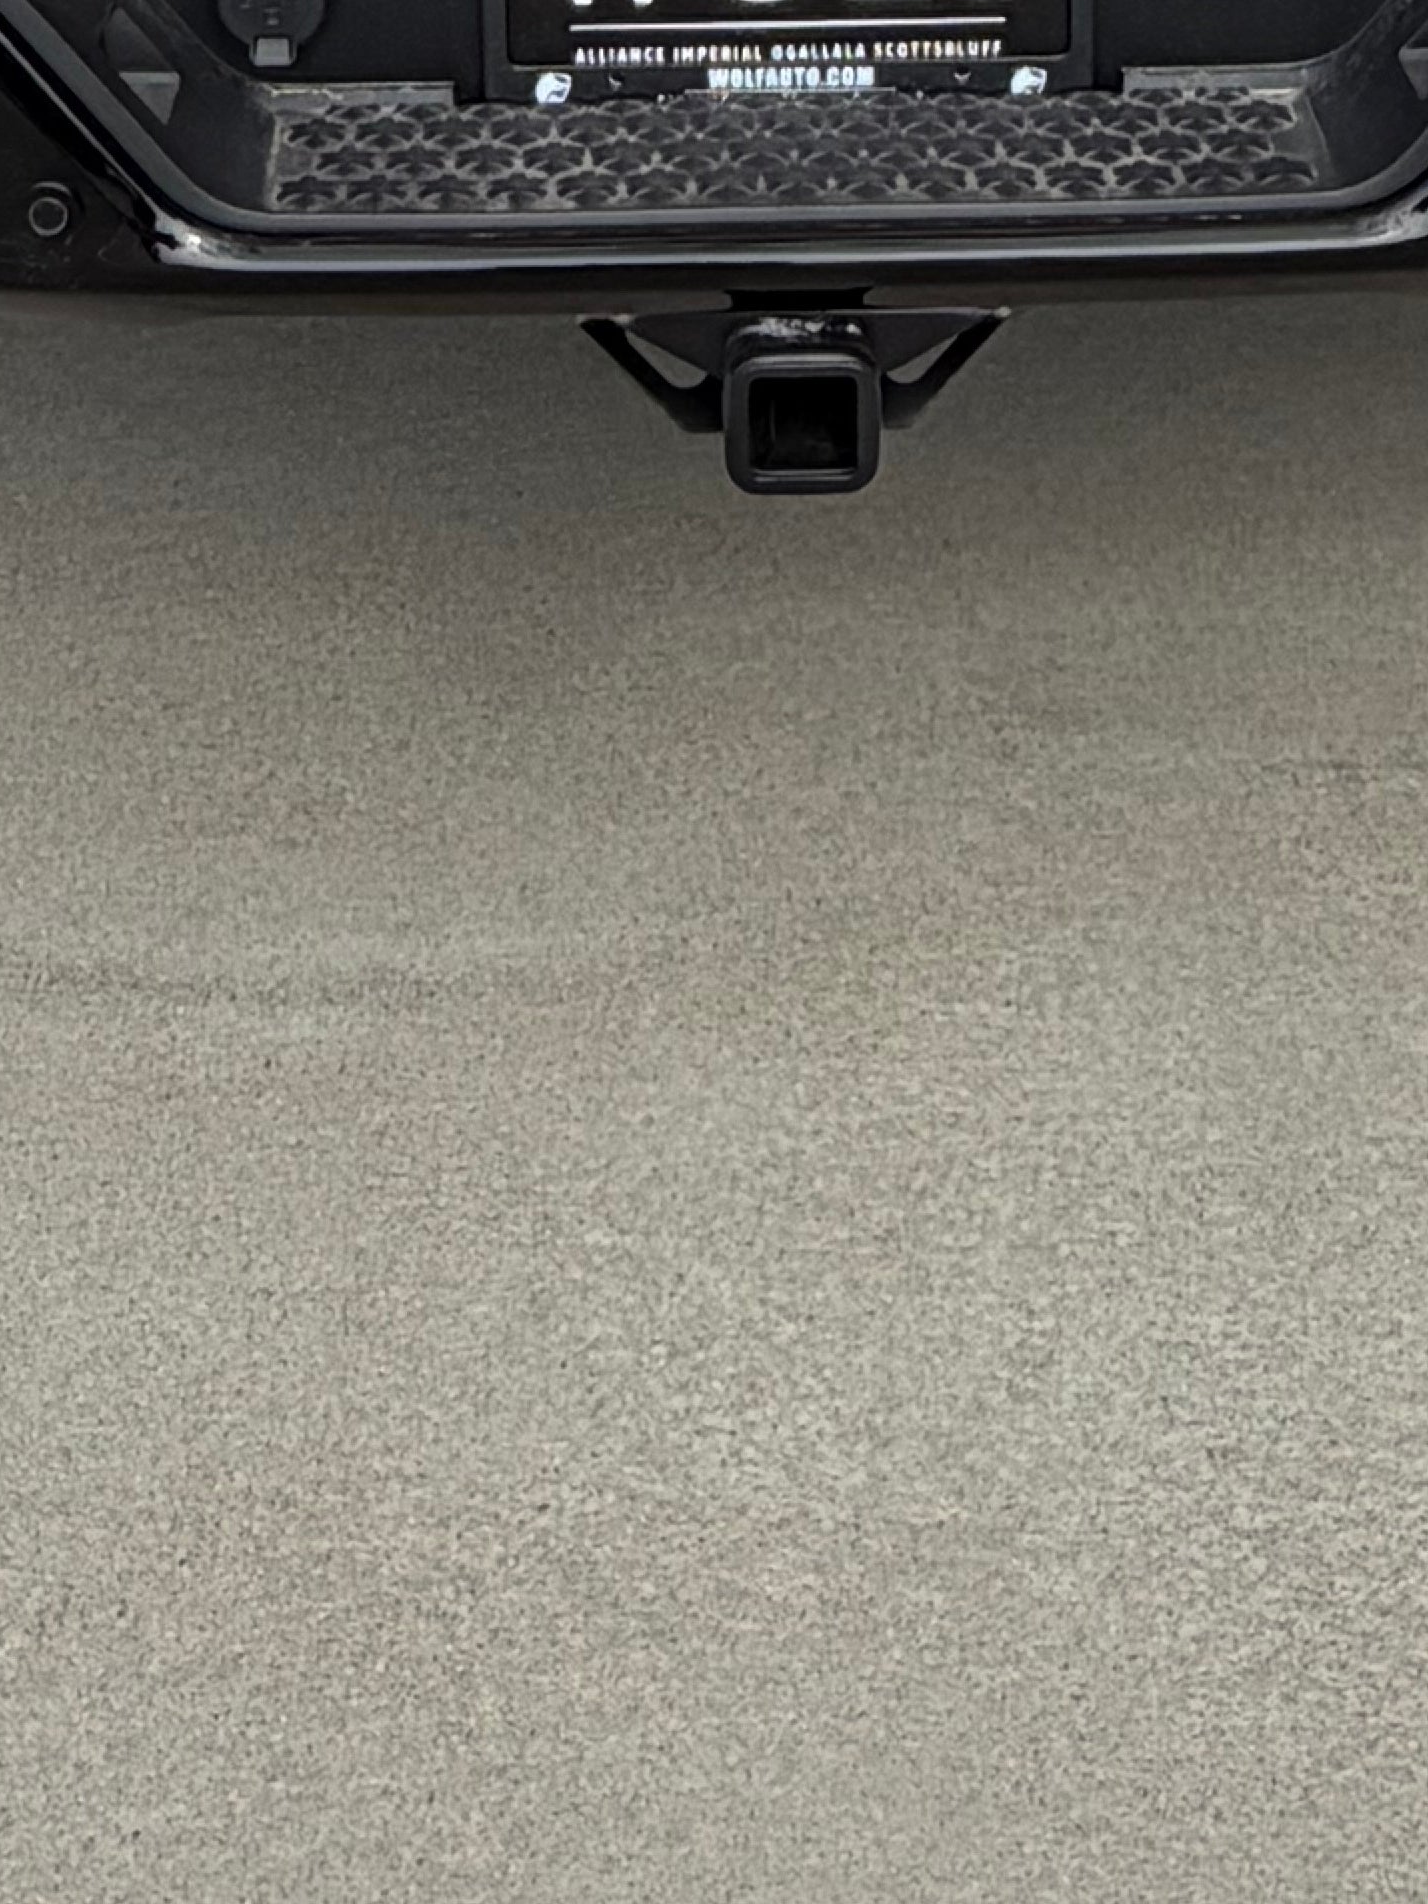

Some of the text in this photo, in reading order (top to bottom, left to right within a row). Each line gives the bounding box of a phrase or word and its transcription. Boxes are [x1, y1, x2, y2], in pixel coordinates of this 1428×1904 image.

[574, 46, 665, 66] ALLIANCE
[672, 44, 762, 65] IMPERIAL
[873, 39, 1003, 59] SCOTTSBLUFF
[707, 66, 876, 89] WOLFAUTO.COM
